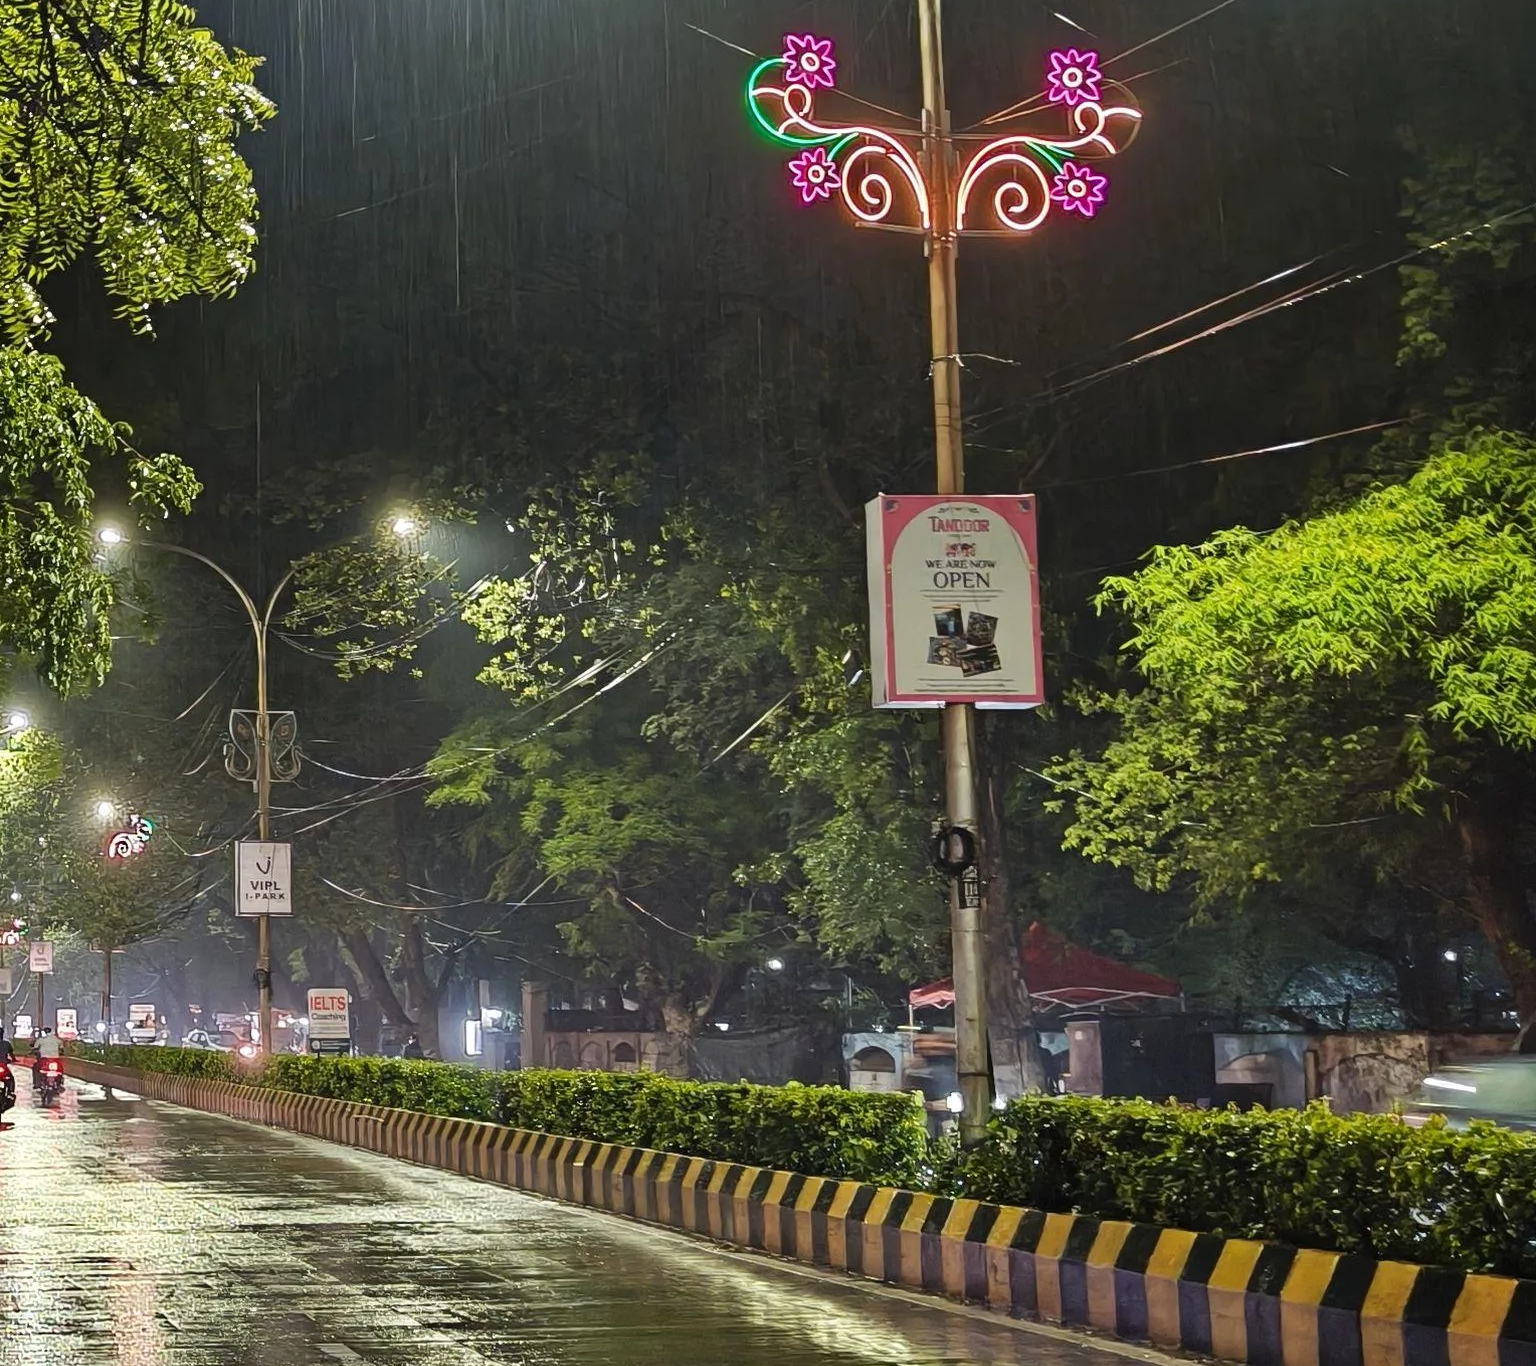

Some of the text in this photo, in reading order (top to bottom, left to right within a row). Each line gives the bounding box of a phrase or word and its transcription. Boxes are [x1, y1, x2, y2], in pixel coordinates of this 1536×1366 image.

[928, 516, 990, 532] TANDOOR
[925, 560, 996, 569] WE ARE NOW
[933, 571, 990, 589] OPEN
[250, 881, 281, 891] VIPL
[310, 996, 346, 1010] IELTS
